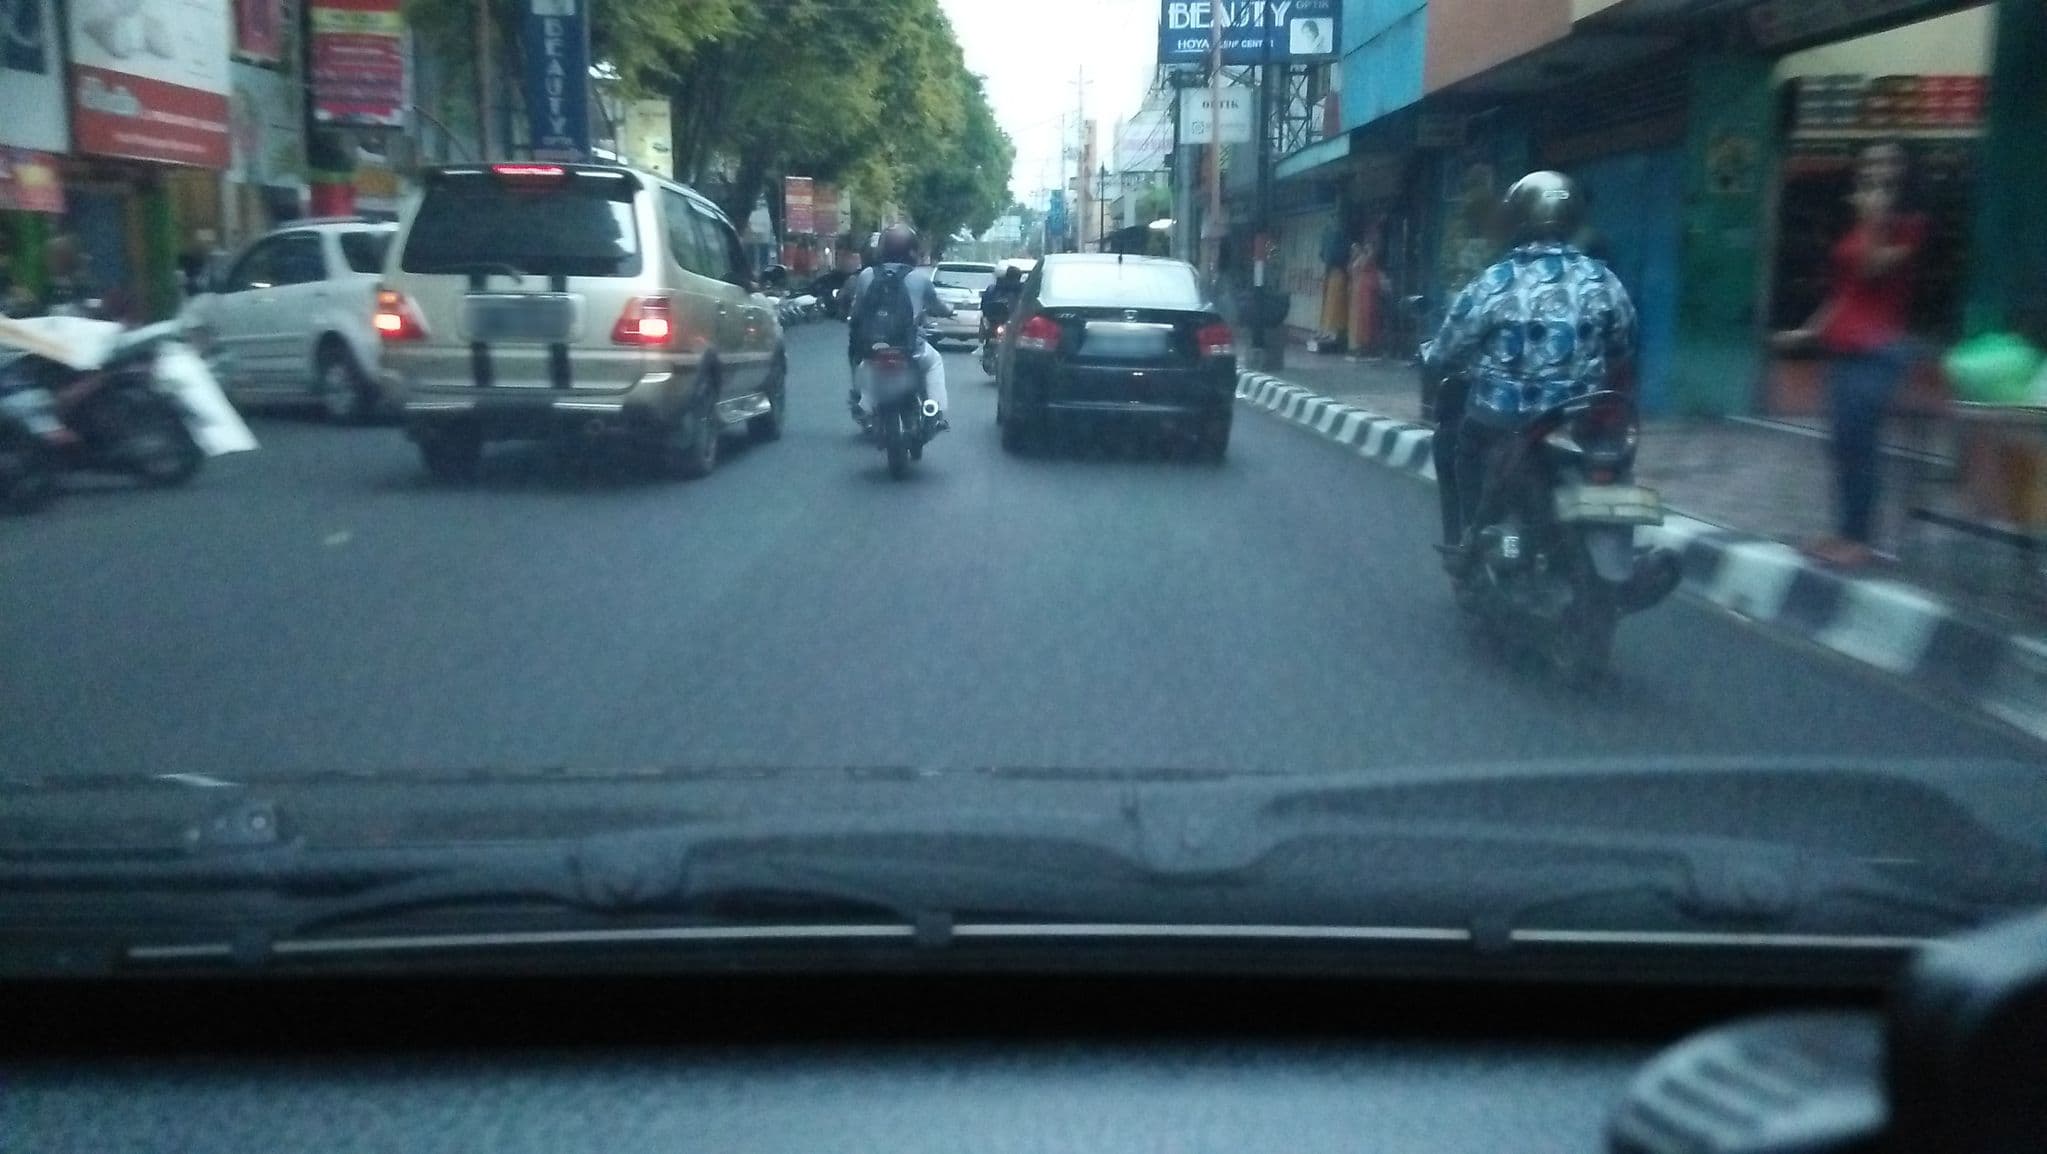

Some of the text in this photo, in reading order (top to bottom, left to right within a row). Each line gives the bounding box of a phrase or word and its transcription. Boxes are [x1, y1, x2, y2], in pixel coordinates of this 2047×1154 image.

[1168, 1, 1291, 28] BEAUTY
[1177, 39, 1209, 49] HOYA
[1241, 40, 1275, 48] CENT
